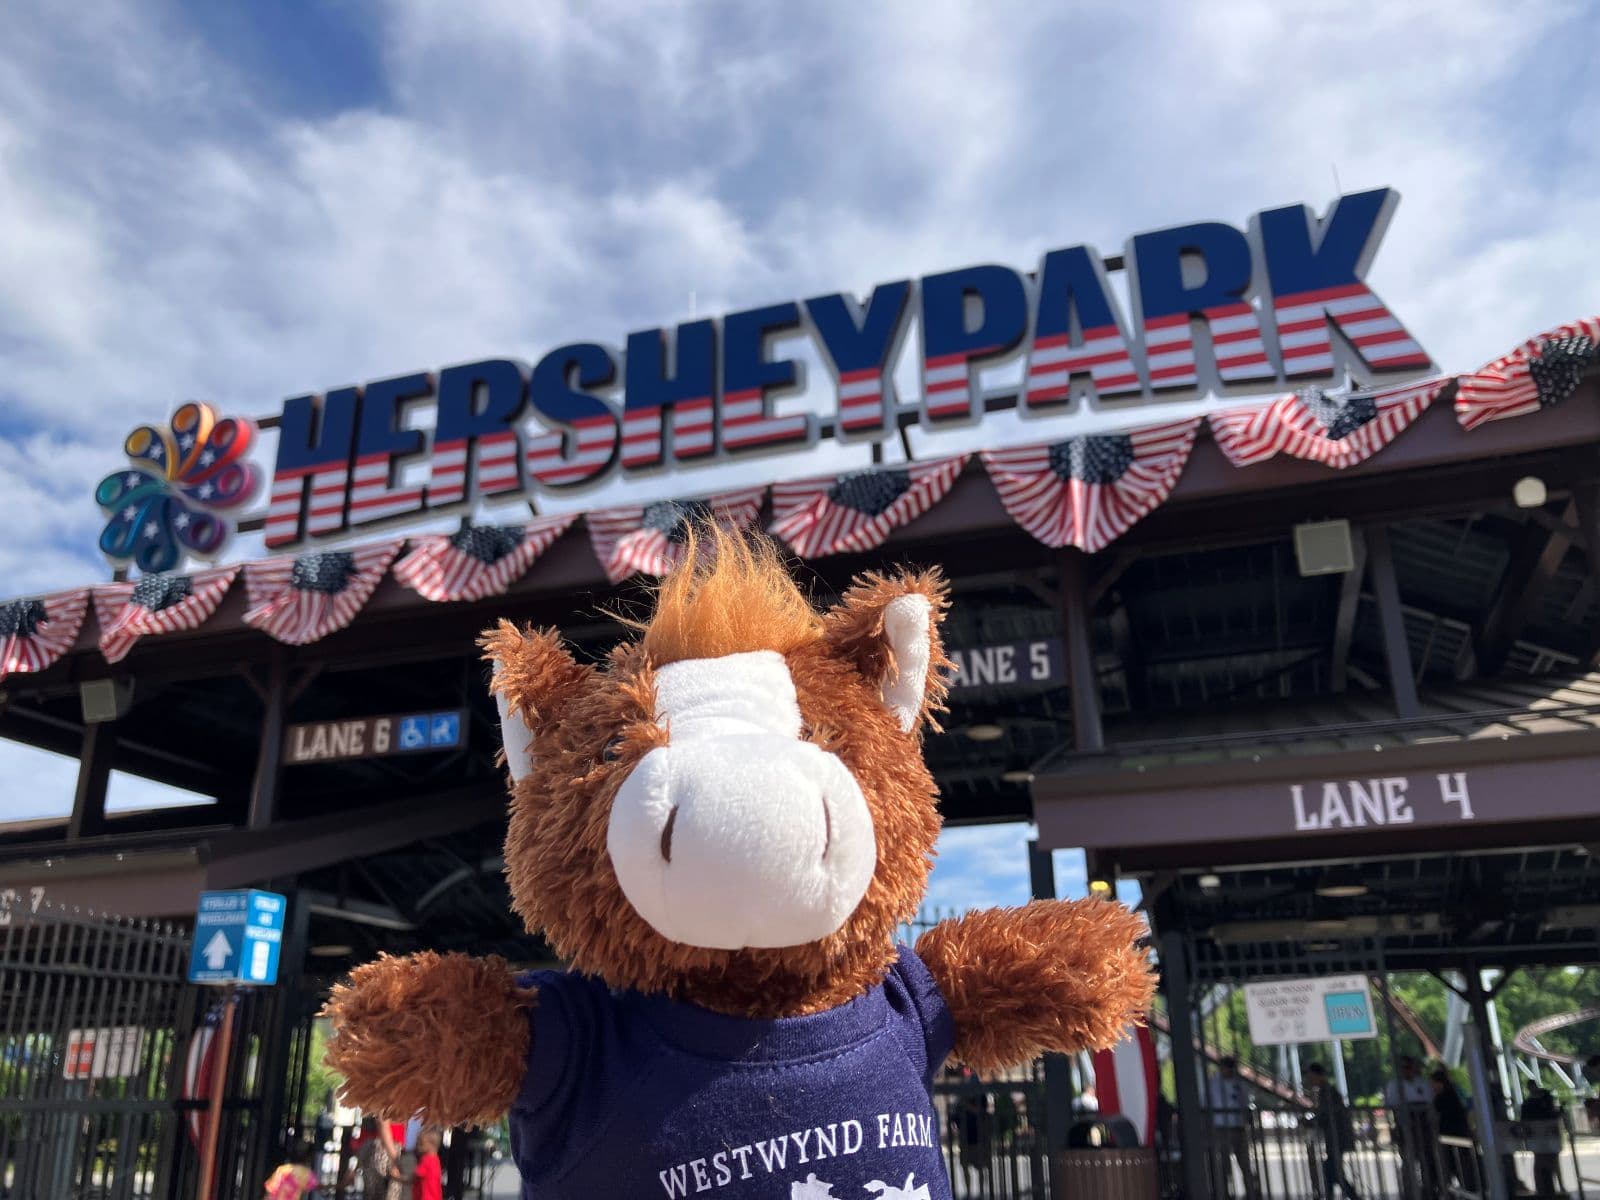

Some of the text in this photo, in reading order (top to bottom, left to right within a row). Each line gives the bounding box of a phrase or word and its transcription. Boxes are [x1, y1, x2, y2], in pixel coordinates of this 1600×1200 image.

[265, 186, 1433, 548] HERSHEYPARK
[947, 641, 1051, 687] ANE 5
[294, 718, 392, 761] LANE 6
[1290, 772, 1476, 831] LANE 4
[659, 1112, 933, 1200] WESTWYND FARM
